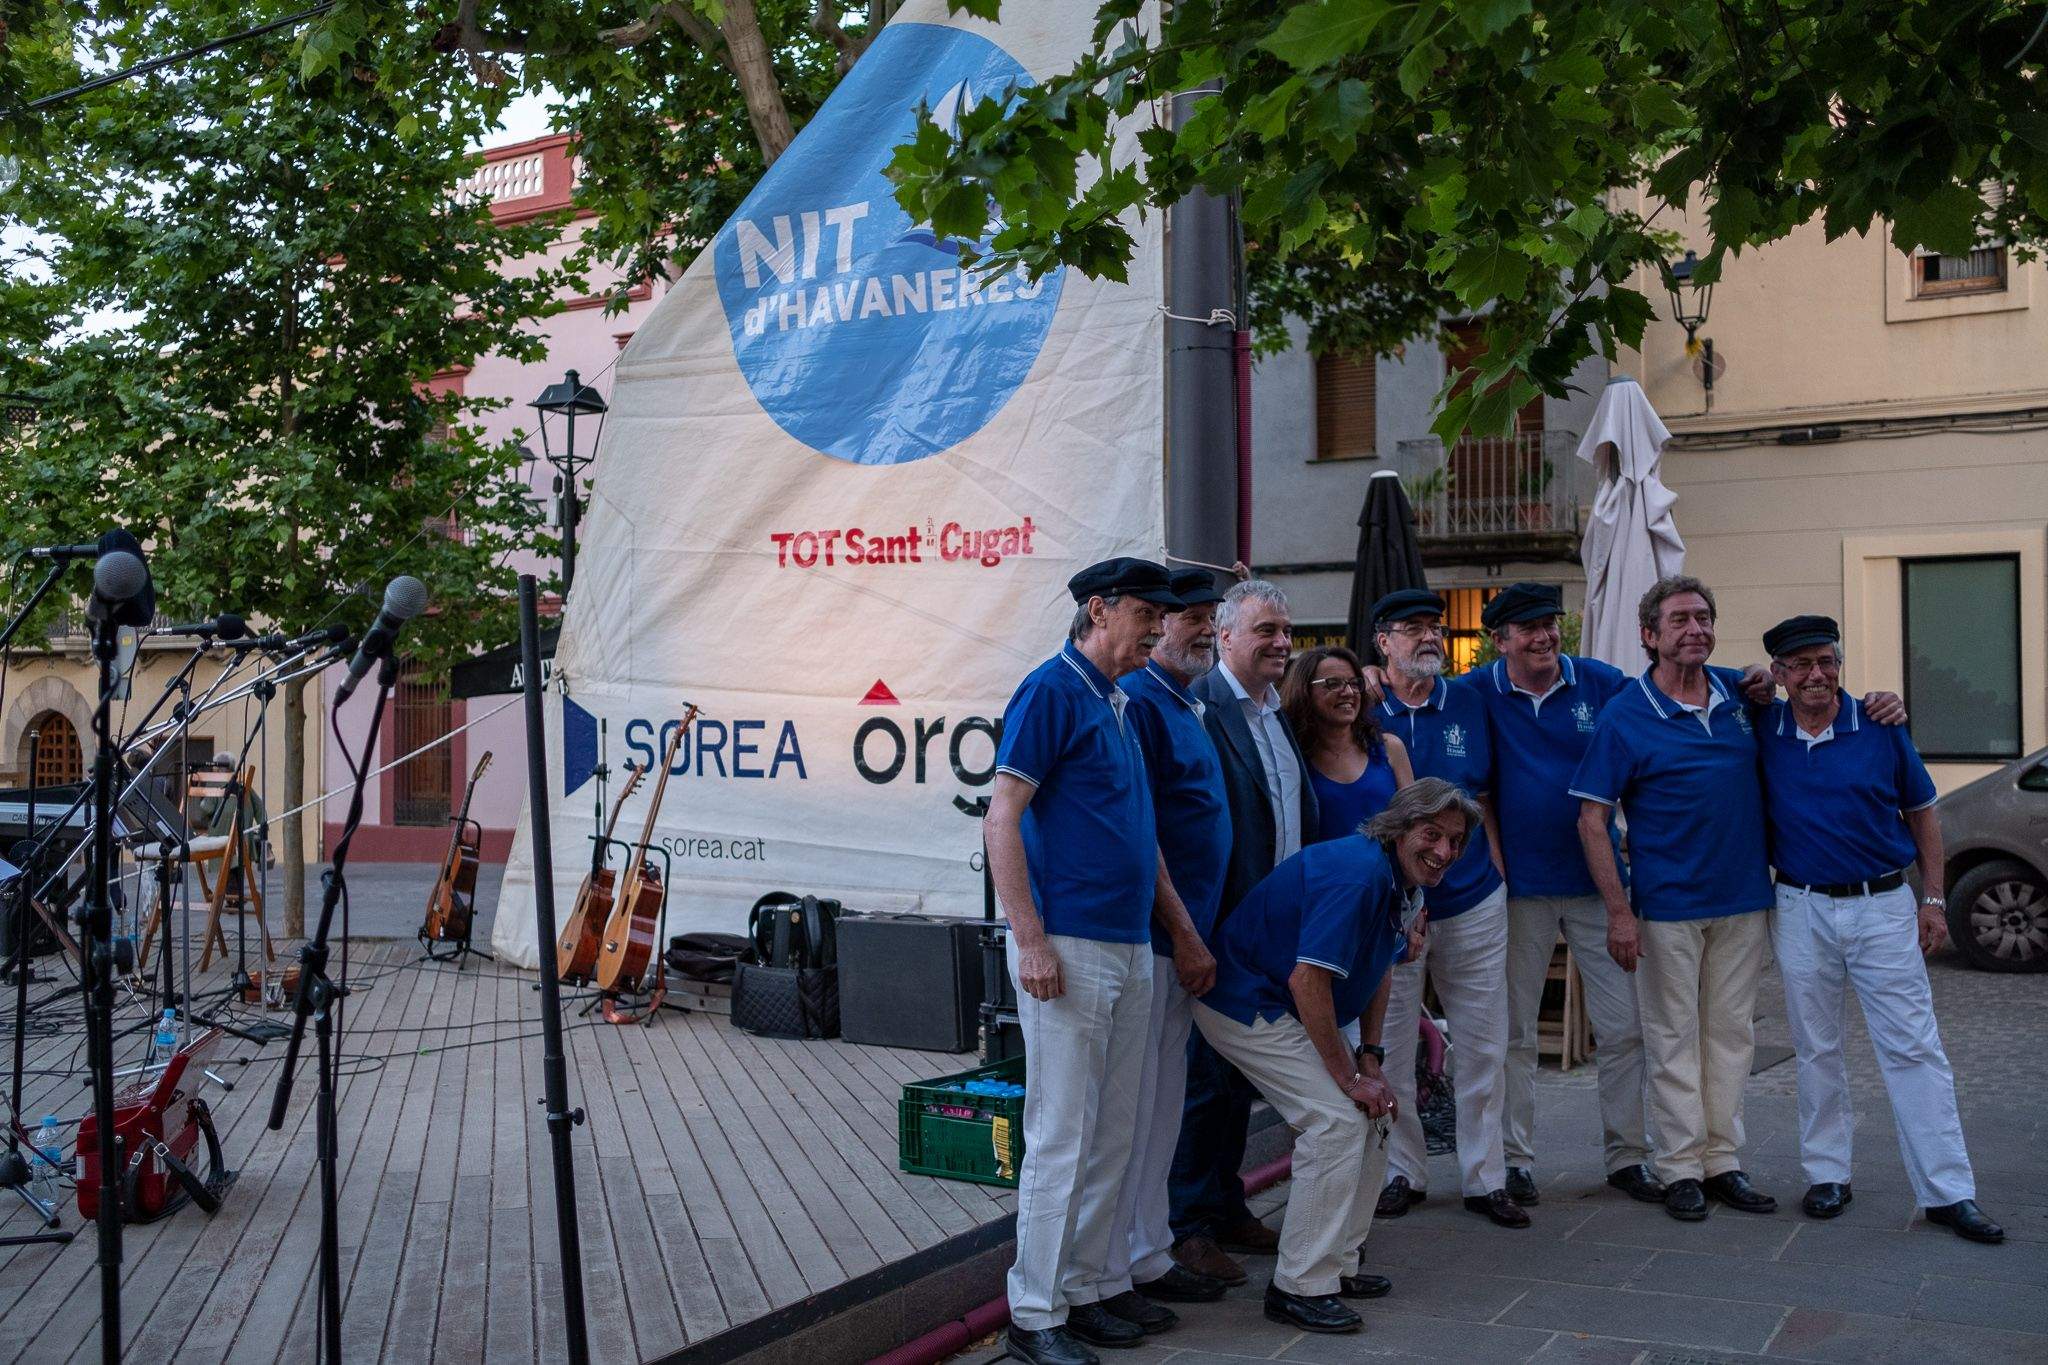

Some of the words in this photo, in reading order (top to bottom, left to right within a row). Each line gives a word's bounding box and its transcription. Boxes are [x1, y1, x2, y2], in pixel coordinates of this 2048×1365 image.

[736, 201, 869, 288] NIT
[771, 529, 841, 568] TOT
[845, 526, 922, 566] Sant
[939, 516, 1036, 568] Cugat
[625, 718, 808, 779] SOREA
[662, 836, 766, 861] sorea.cat
